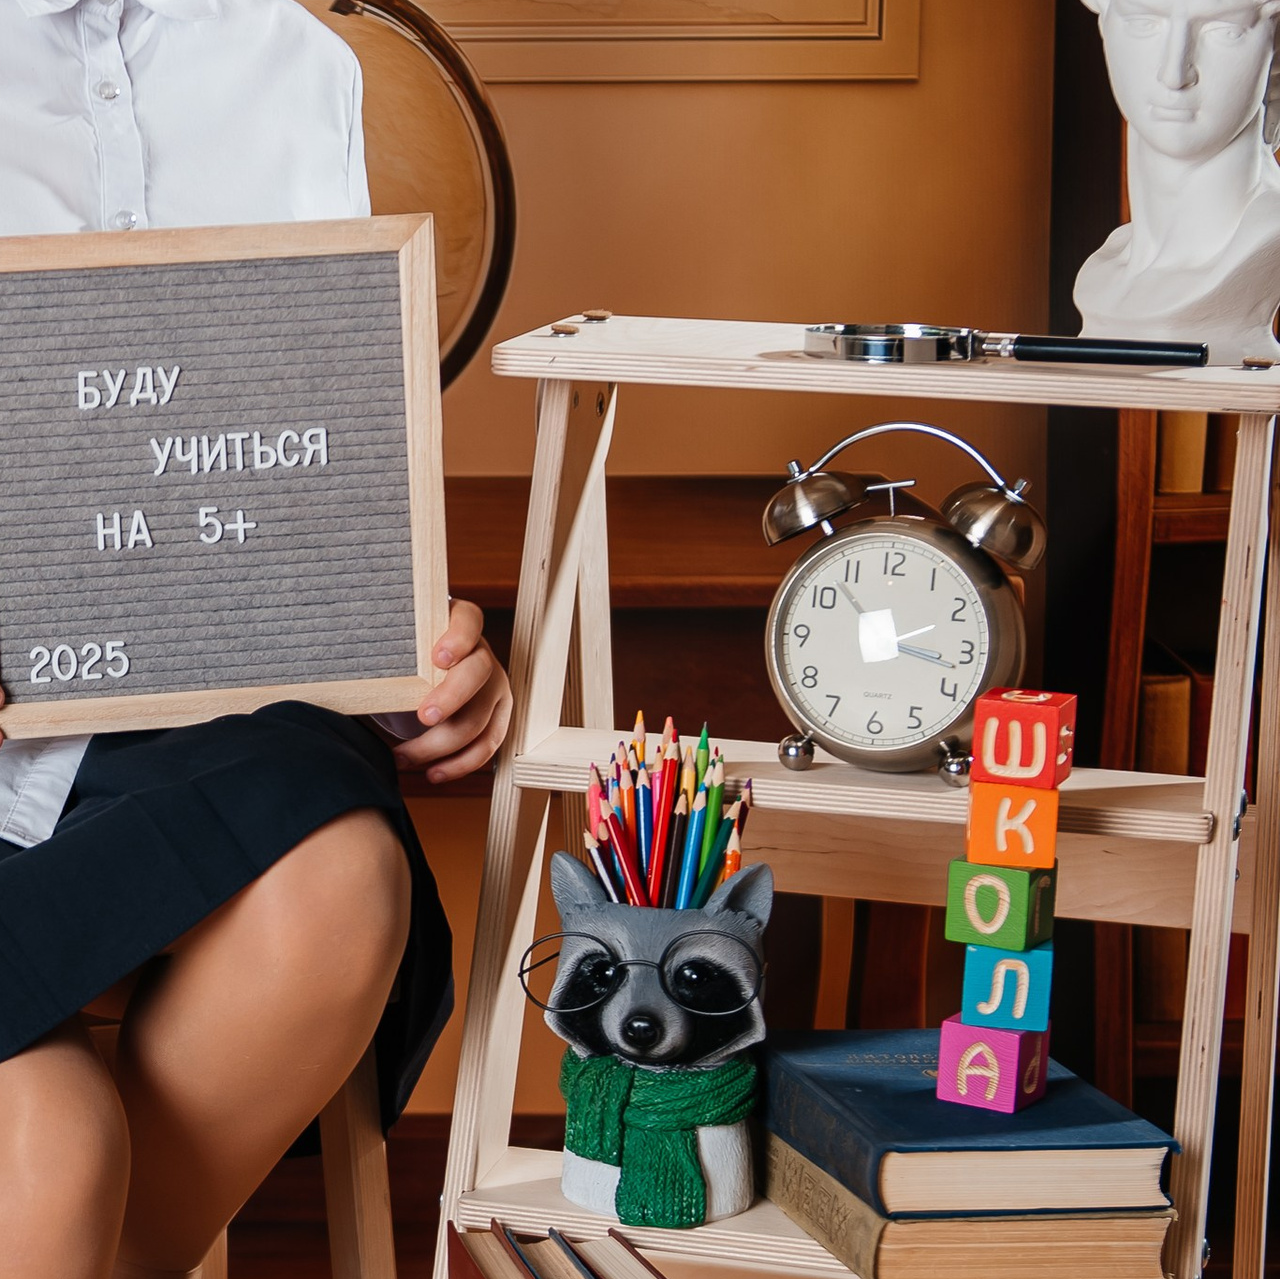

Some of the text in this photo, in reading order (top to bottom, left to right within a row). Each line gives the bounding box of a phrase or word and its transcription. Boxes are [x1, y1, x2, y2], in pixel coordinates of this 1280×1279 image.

[76, 365, 181, 411] БУДУ
[149, 427, 330, 477] УЧИТЬСЯ
[95, 505, 259, 552] НА 5+
[844, 559, 861, 584] 11
[883, 551, 907, 577] 12
[930, 567, 937, 592] 1
[811, 584, 838, 610] 10
[951, 597, 967, 623] 2
[793, 623, 811, 648] 9
[28, 639, 131, 685] 2025
[958, 639, 976, 665] 3
[801, 665, 818, 689] 8
[940, 677, 958, 702] 4
[825, 694, 842, 718] 7
[863, 691, 893, 701] QUARTZ
[866, 710, 884, 735] 6
[907, 706, 923, 730] 5
